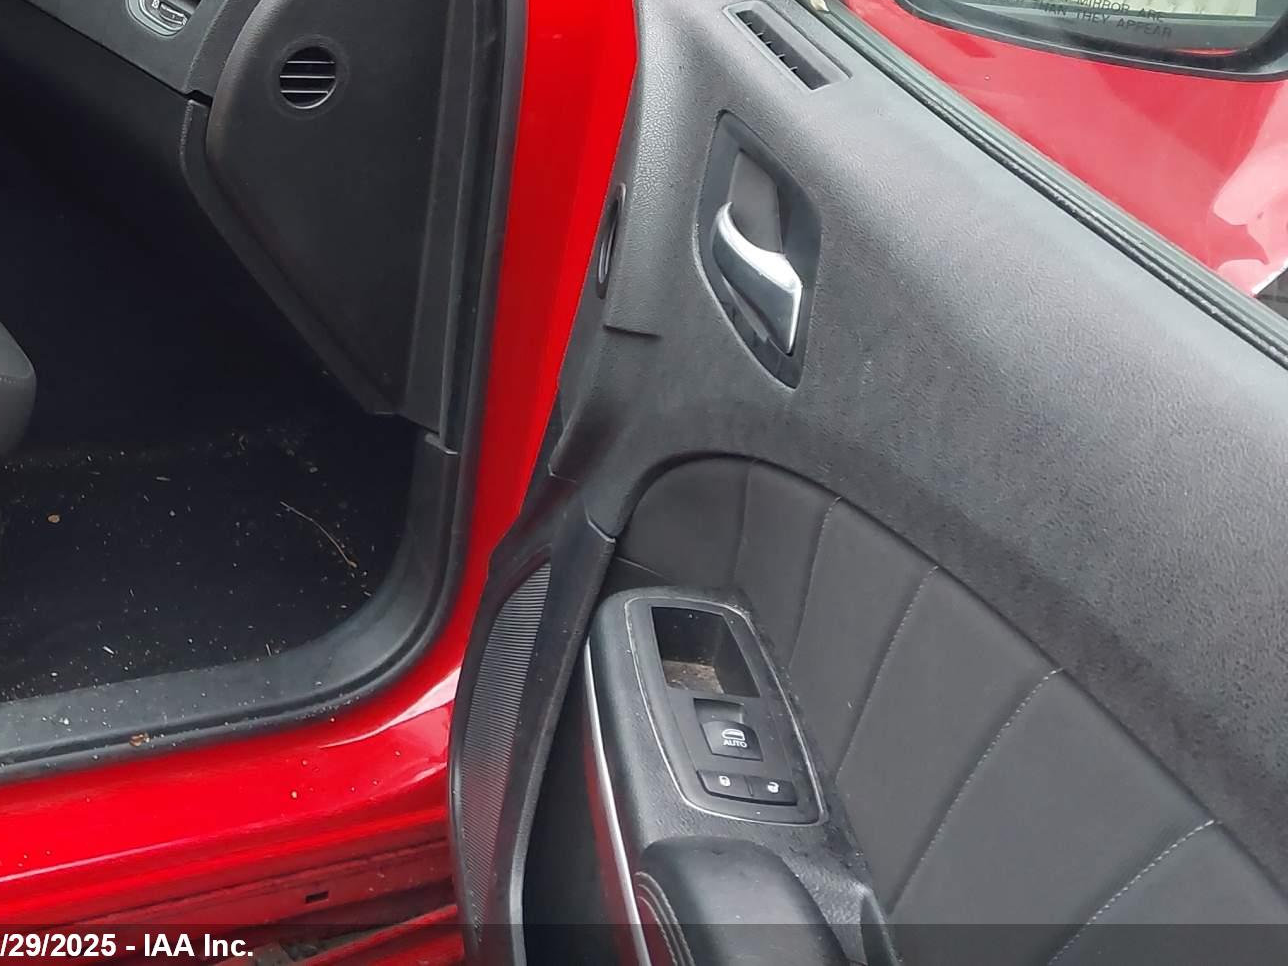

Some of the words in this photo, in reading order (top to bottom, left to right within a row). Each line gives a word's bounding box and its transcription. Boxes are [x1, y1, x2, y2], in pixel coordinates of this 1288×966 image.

[1076, 9, 1110, 24] THEY
[1116, 18, 1172, 37] APPEAR
[1136, 8, 1164, 23] ARE
[723, 739, 748, 749] AUTO
